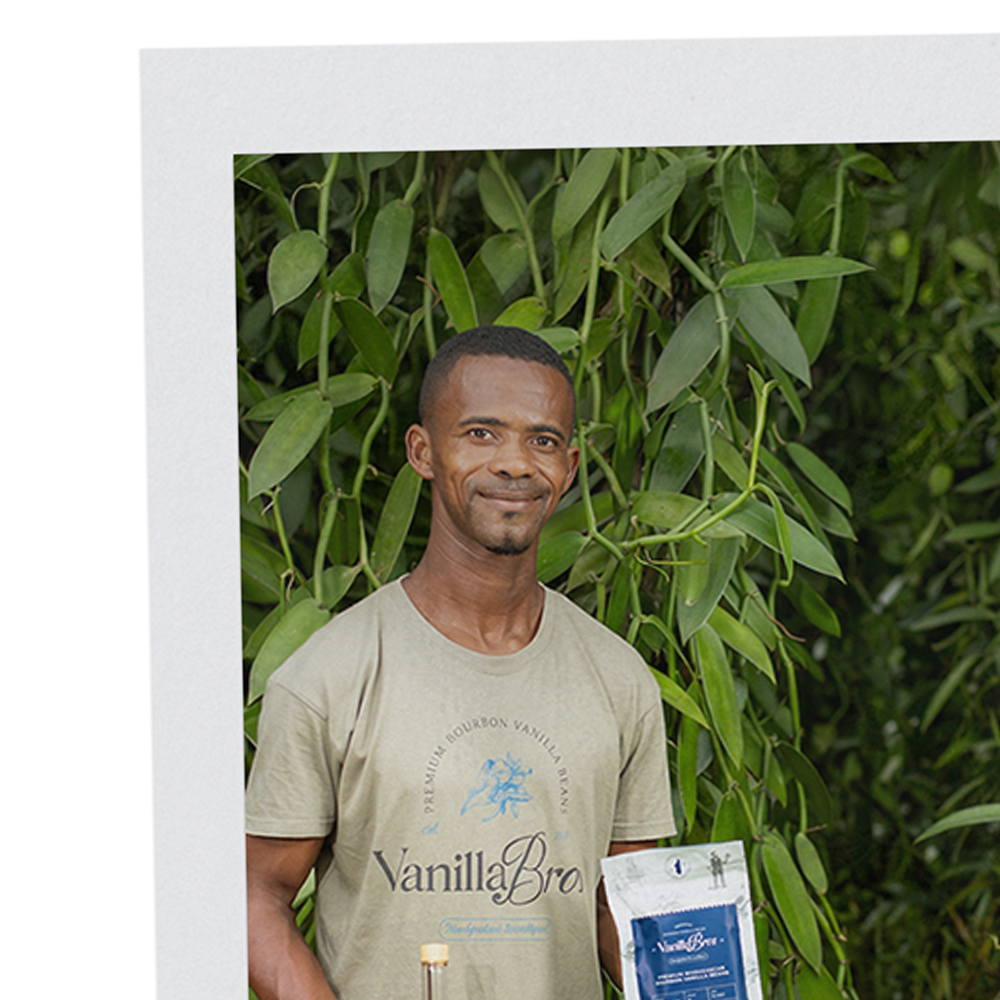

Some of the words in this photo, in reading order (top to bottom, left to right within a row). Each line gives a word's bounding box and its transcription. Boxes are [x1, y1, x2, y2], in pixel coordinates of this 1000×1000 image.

[424, 745, 447, 815] PREMIUM
[446, 716, 509, 744] BOURBON
[513, 720, 563, 764] VANILLA
